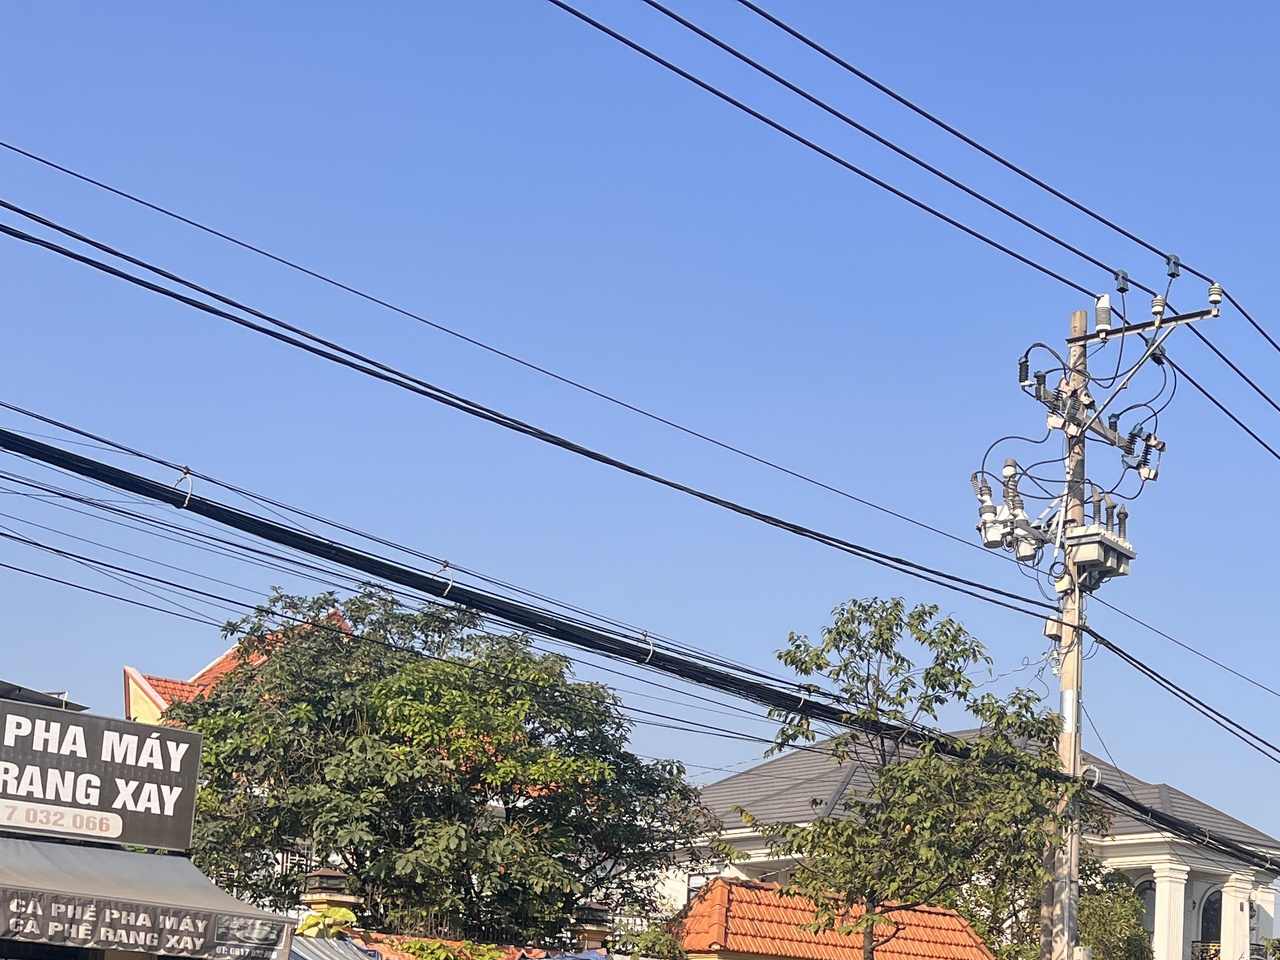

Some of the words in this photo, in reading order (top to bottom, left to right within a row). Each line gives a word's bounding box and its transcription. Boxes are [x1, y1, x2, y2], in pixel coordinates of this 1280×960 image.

[4, 714, 88, 759] PHA
[101, 732, 190, 772] MÁY
[0, 761, 101, 806] RANG
[111, 778, 183, 816] XAY
[25, 808, 65, 827] 032
[72, 814, 110, 832] 066
[9, 917, 41, 935] CÀ
[48, 921, 93, 940] PHÊ
[100, 927, 159, 947] RANG
[165, 934, 205, 951] XAY
[51, 902, 97, 921] PHÊ
[104, 908, 152, 928] PHA
[159, 915, 208, 933] MÁY
